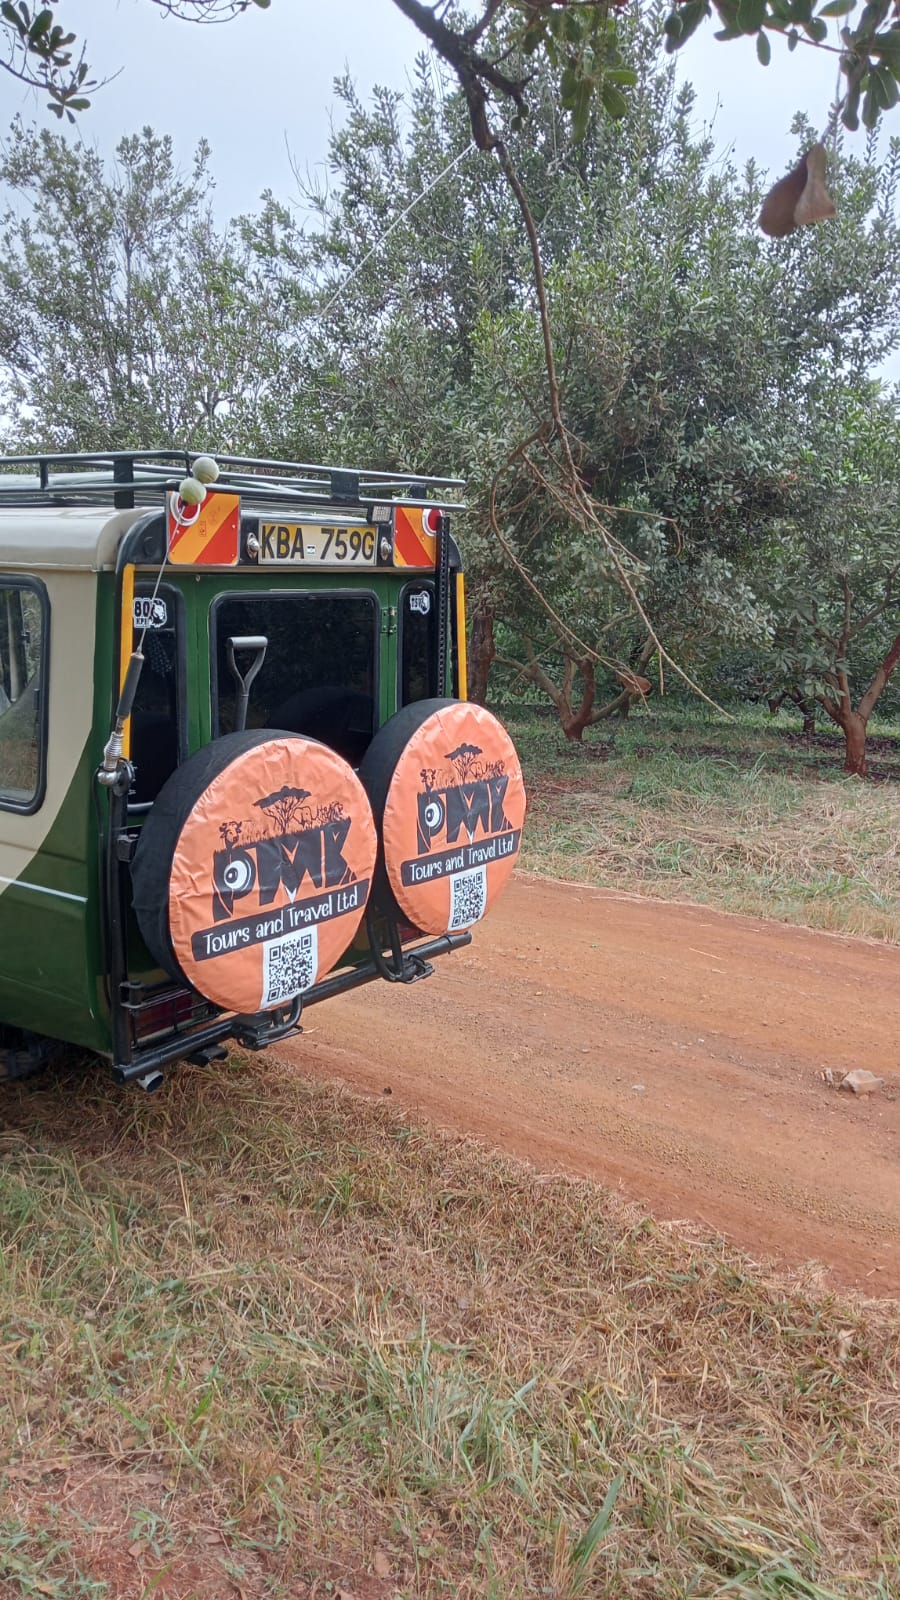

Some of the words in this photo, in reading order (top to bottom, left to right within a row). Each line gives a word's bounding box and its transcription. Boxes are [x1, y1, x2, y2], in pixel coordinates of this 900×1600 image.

[262, 525, 305, 560] KBA
[320, 527, 375, 561] 759G
[134, 601, 150, 617] 80
[416, 774, 513, 855] PMK
[212, 815, 358, 922] PMK
[409, 861, 442, 882] Tours
[445, 852, 464, 871] and
[468, 841, 496, 866] Travel
[498, 834, 513, 856] Ltd
[204, 928, 250, 955] Tours
[255, 915, 284, 939] and
[288, 895, 333, 928] Travel
[337, 885, 358, 913] Ltd
